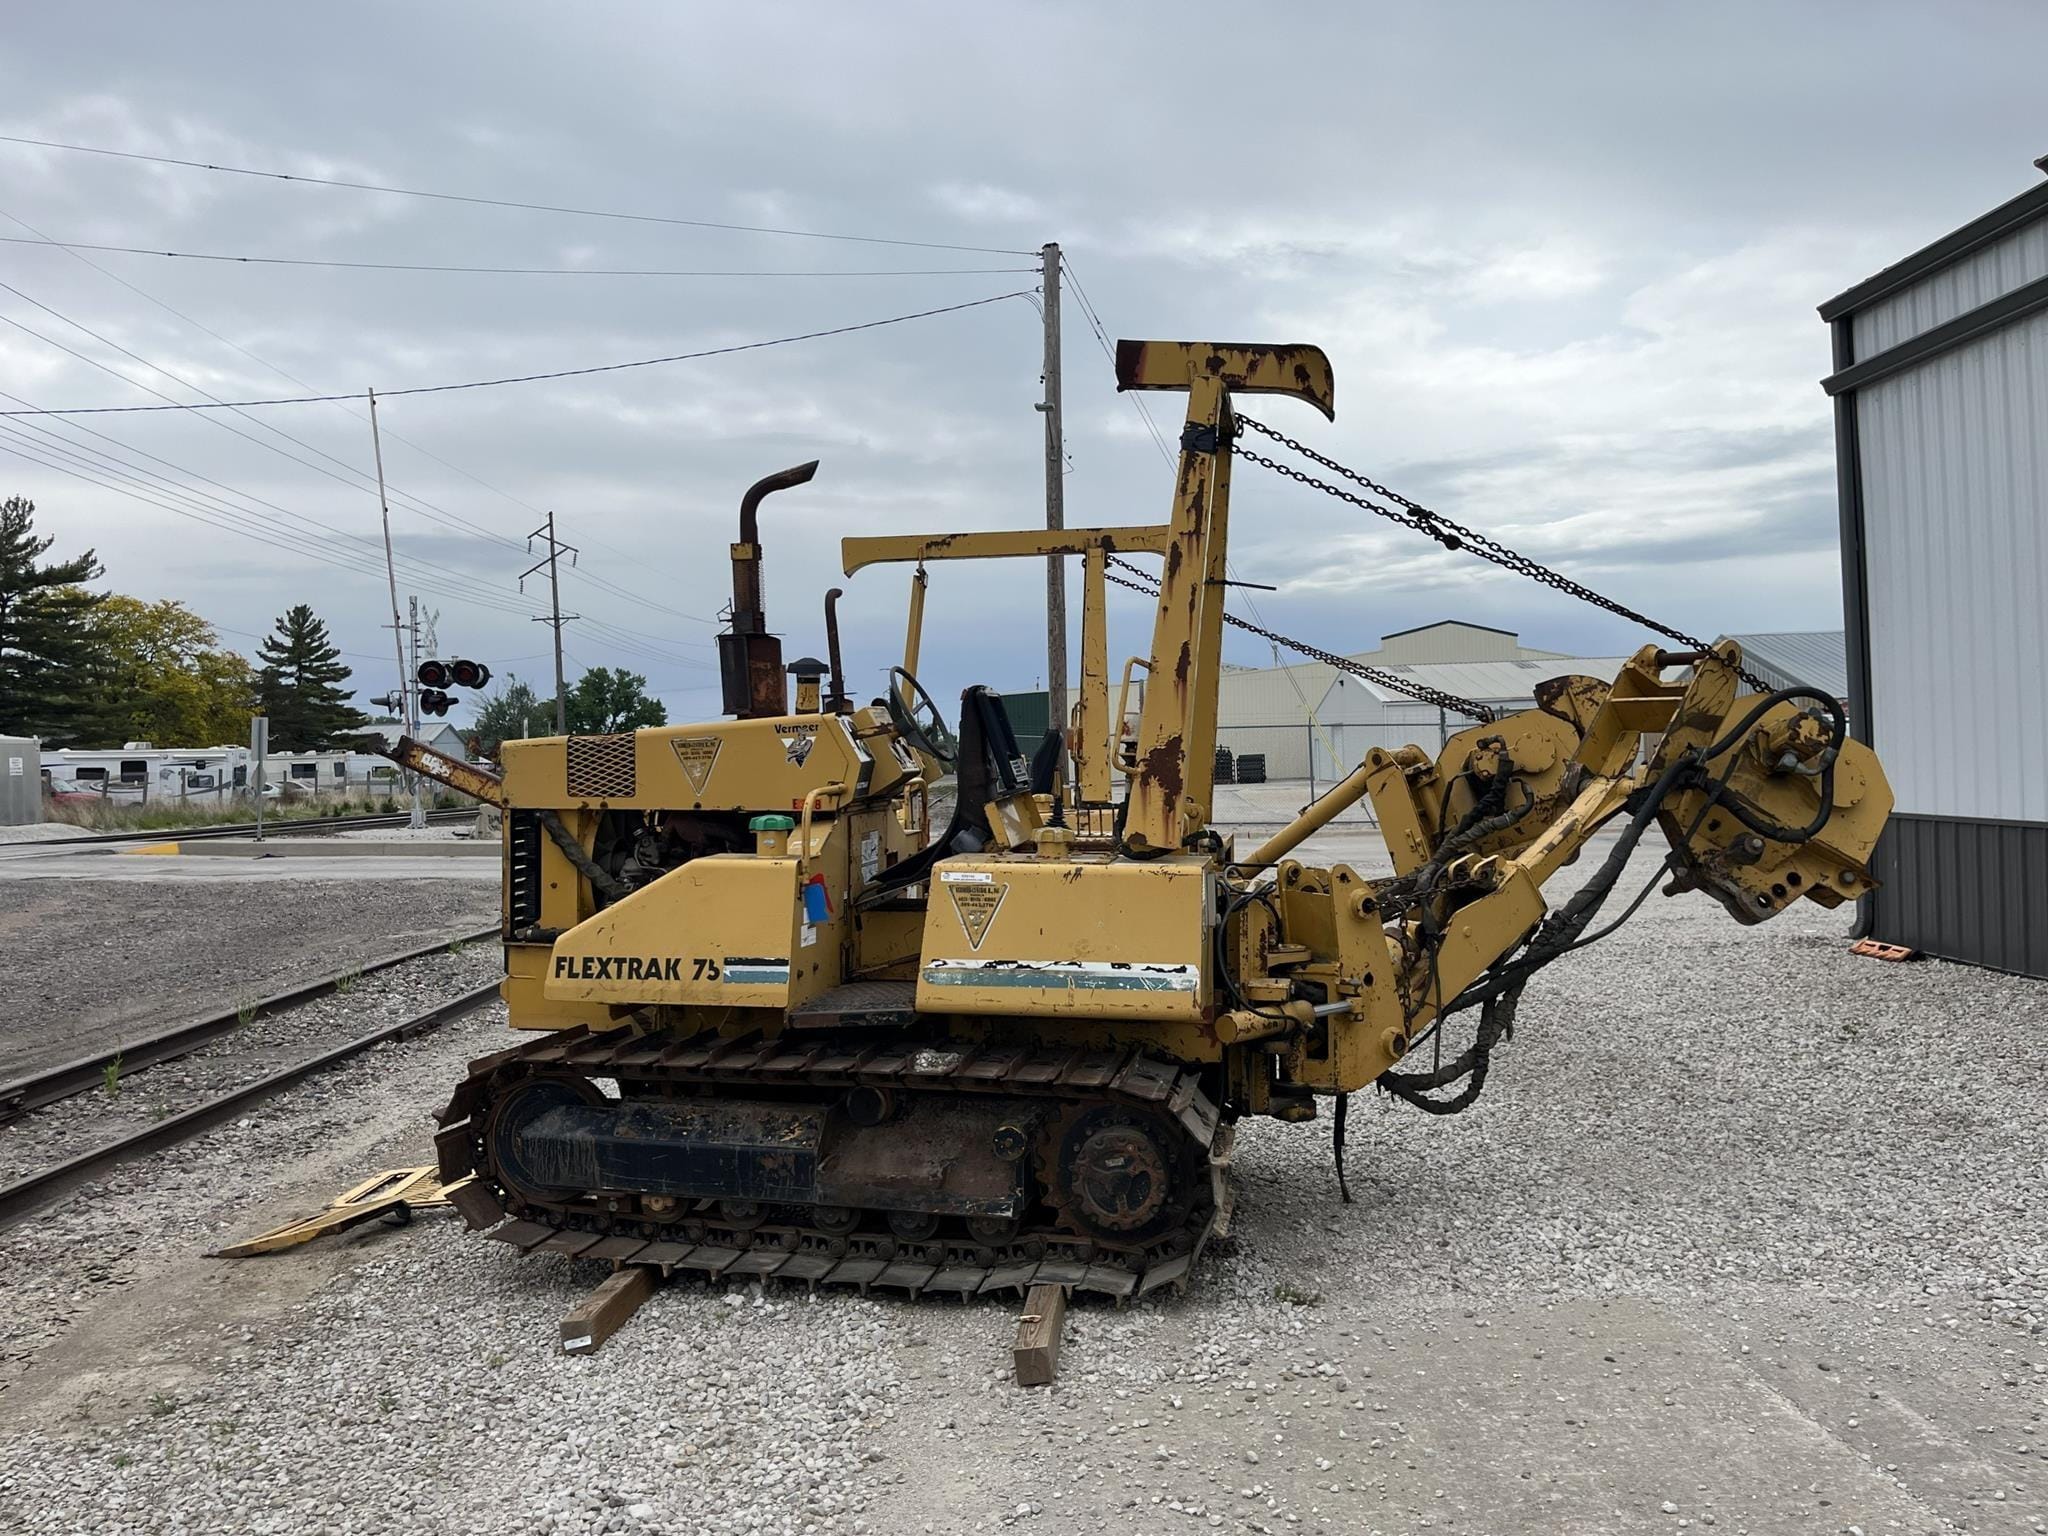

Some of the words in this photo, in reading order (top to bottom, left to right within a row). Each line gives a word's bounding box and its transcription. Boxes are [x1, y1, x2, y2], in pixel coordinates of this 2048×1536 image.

[774, 723, 820, 734] Vermeer
[555, 956, 682, 981] FLEXTRAK
[692, 958, 721, 981] 75
